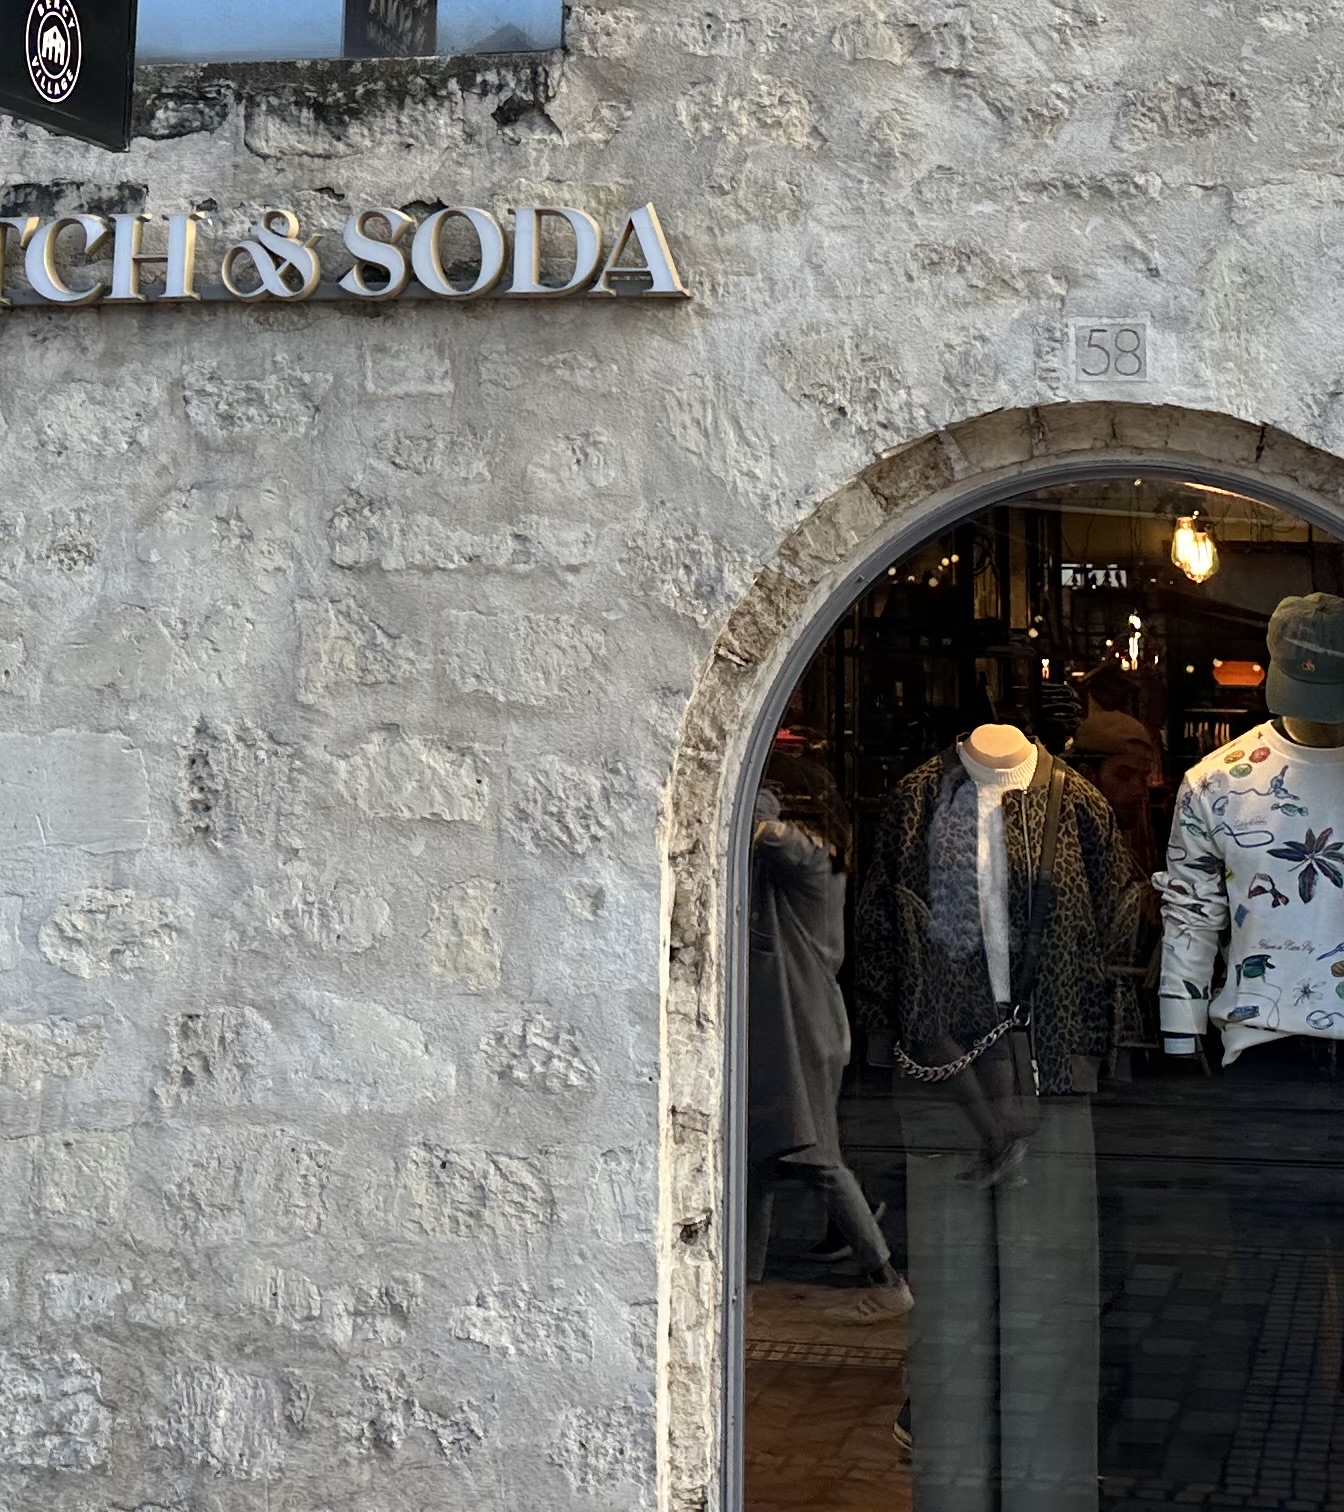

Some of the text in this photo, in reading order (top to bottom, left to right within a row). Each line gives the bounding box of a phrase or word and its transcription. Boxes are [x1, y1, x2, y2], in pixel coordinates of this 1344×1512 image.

[31, 55, 74, 96] VILLAGE
[221, 209, 321, 302] &
[337, 201, 691, 302] SODA
[1081, 328, 1143, 376] 58
